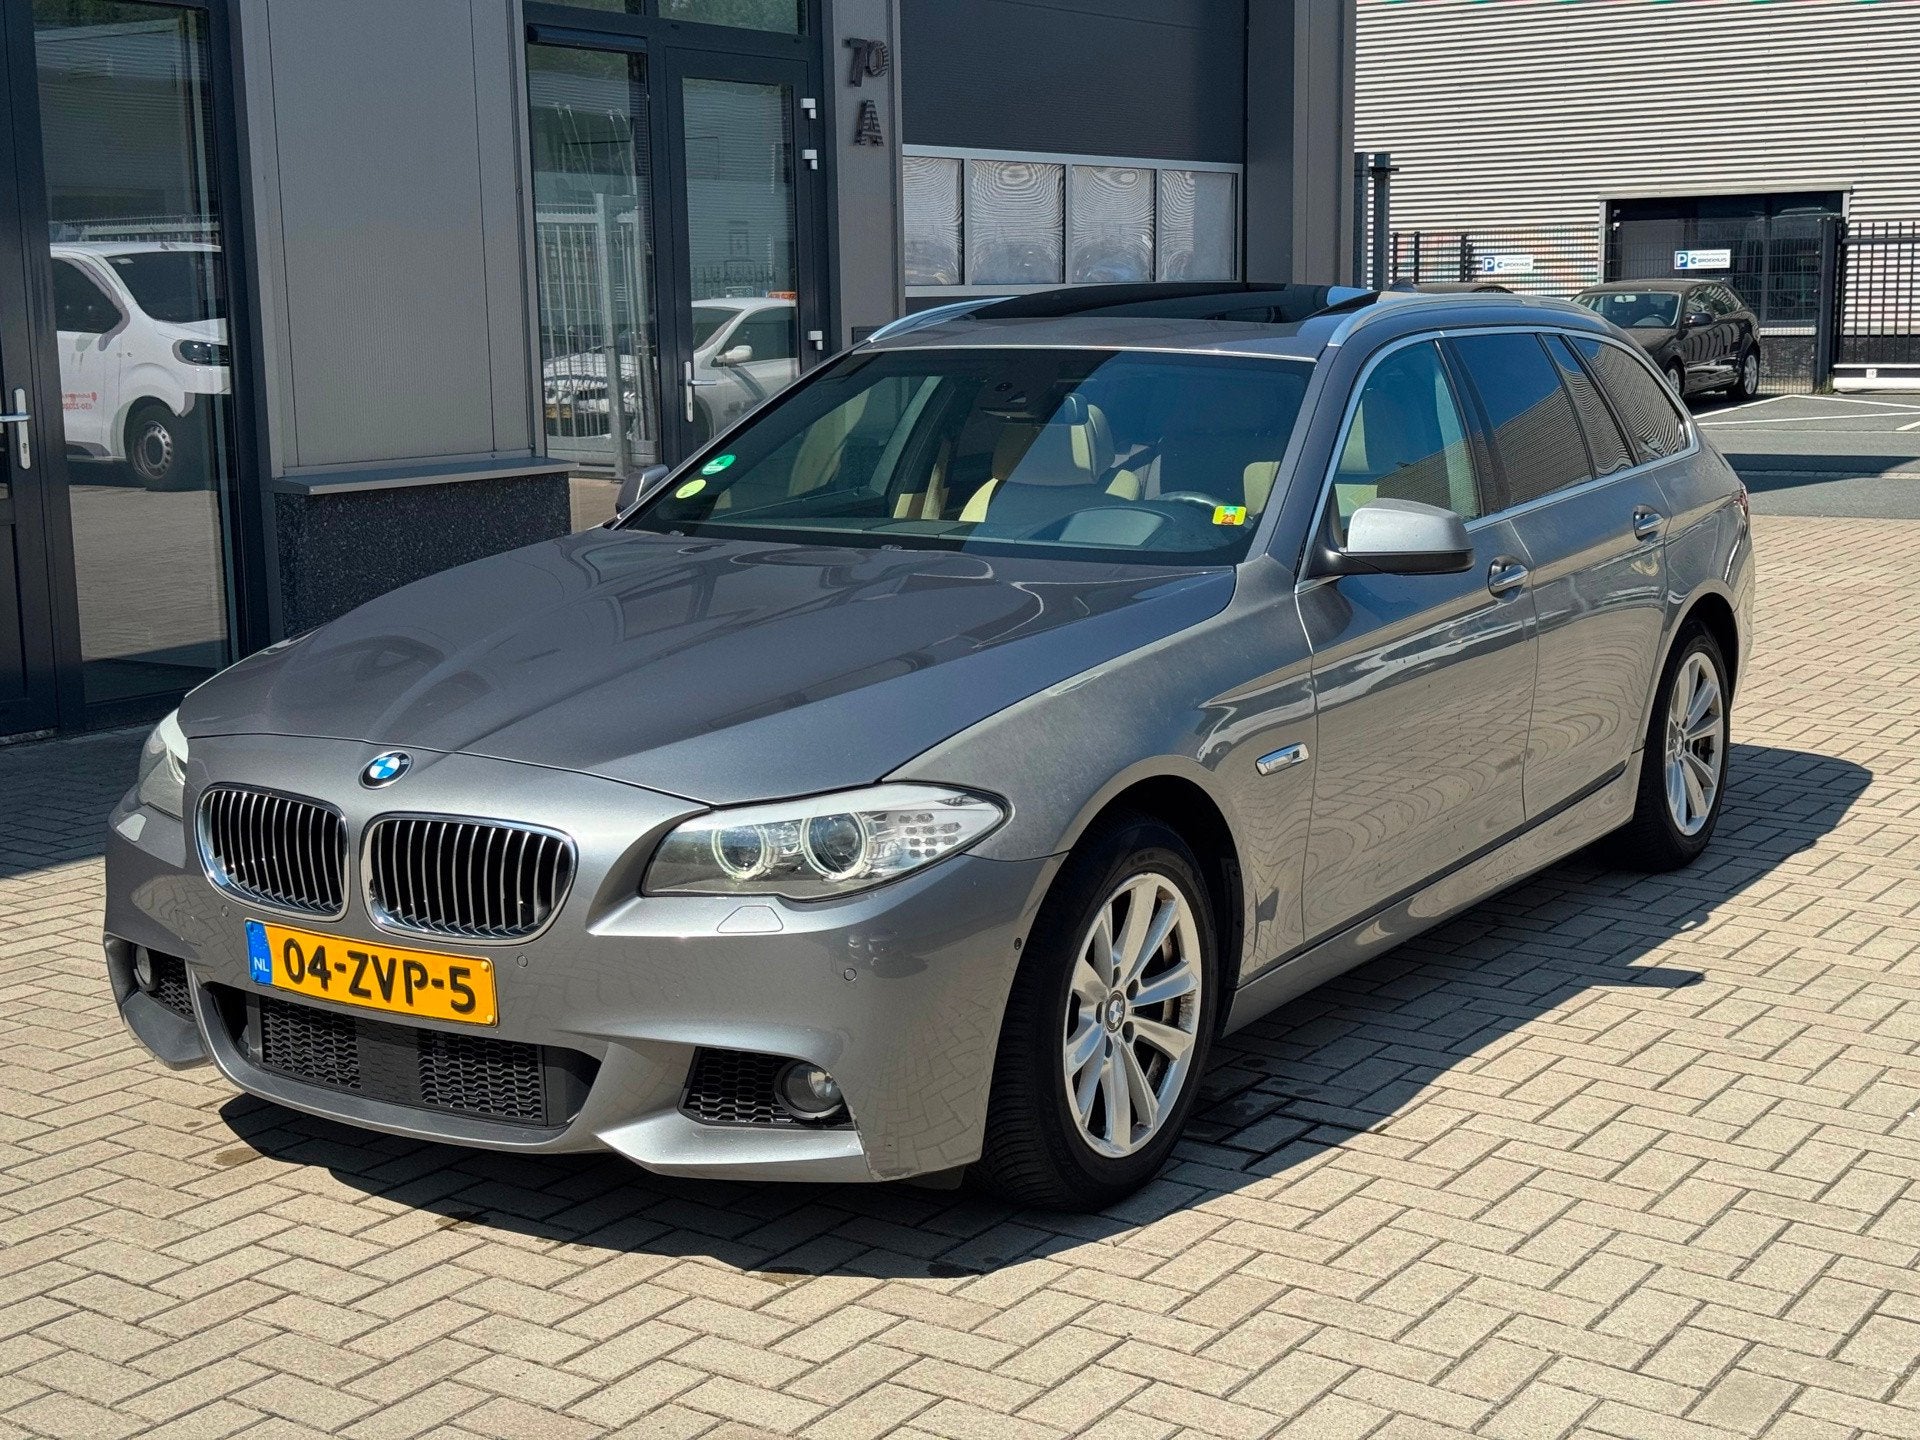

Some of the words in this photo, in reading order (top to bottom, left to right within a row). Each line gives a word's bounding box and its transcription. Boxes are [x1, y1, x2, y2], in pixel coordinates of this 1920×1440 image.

[842, 37, 889, 88] 70
[853, 99, 885, 147] A
[1484, 258, 1495, 271] P
[1676, 253, 1687, 267] P
[253, 956, 270, 973] NL
[283, 937, 477, 1014] 04-ZVP-5
